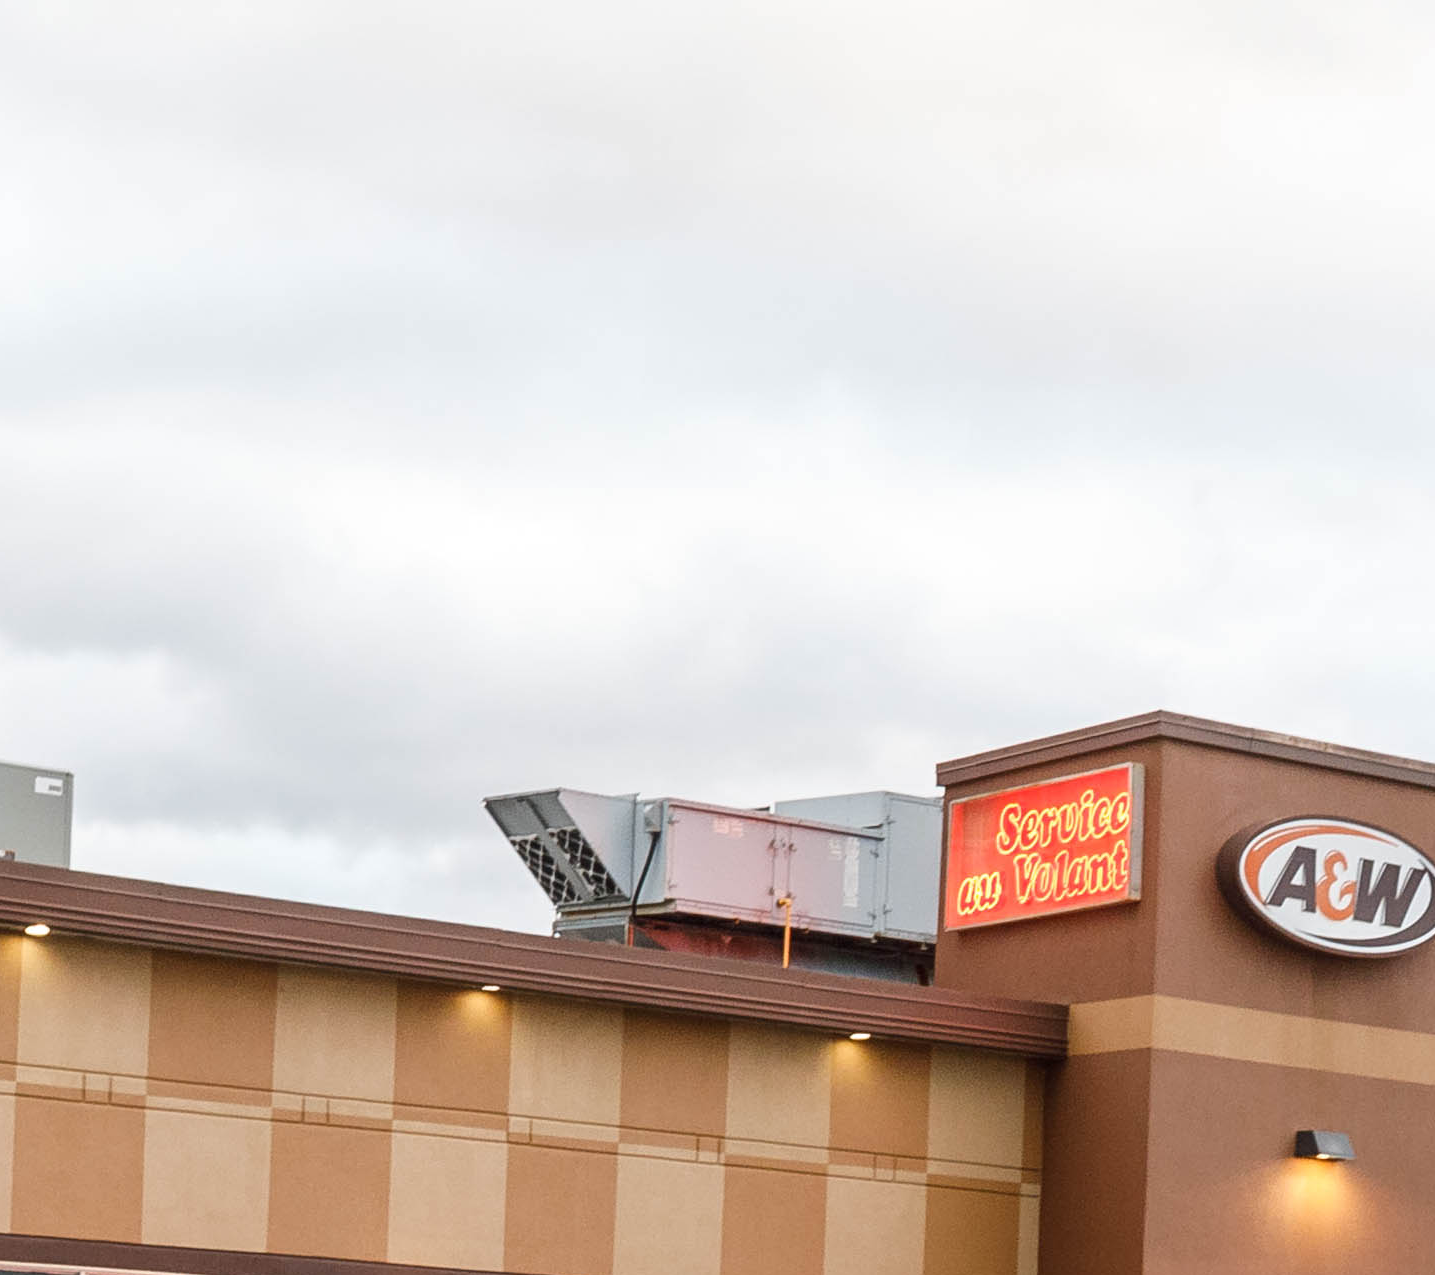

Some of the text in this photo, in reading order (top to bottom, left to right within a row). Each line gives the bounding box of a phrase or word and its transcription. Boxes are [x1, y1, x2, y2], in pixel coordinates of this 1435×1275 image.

[997, 790, 1130, 855] Service
[957, 839, 1128, 915] au Volant
[1265, 846, 1428, 928] A&W
